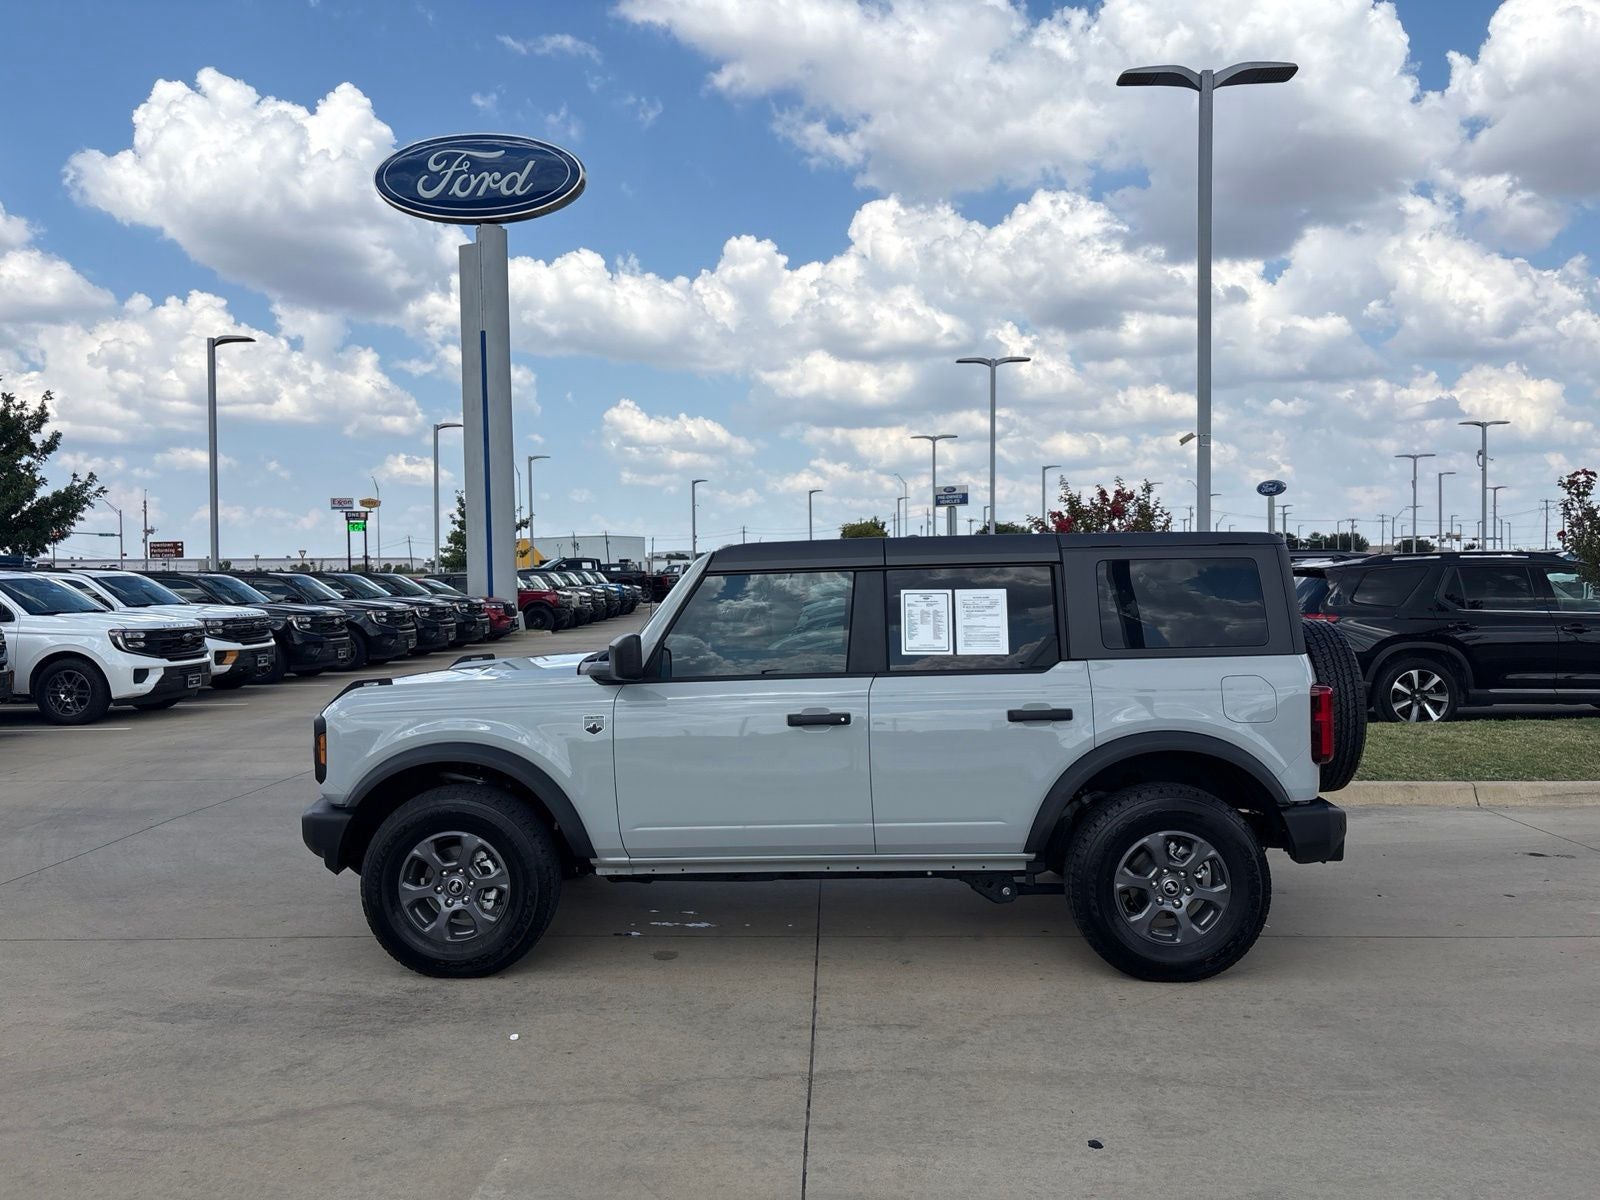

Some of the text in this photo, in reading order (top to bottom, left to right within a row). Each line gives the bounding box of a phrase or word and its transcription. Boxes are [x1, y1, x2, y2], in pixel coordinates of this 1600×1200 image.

[416, 149, 535, 199] Ford
[1260, 483, 1277, 493] Ford
[332, 498, 353, 507] Exxon
